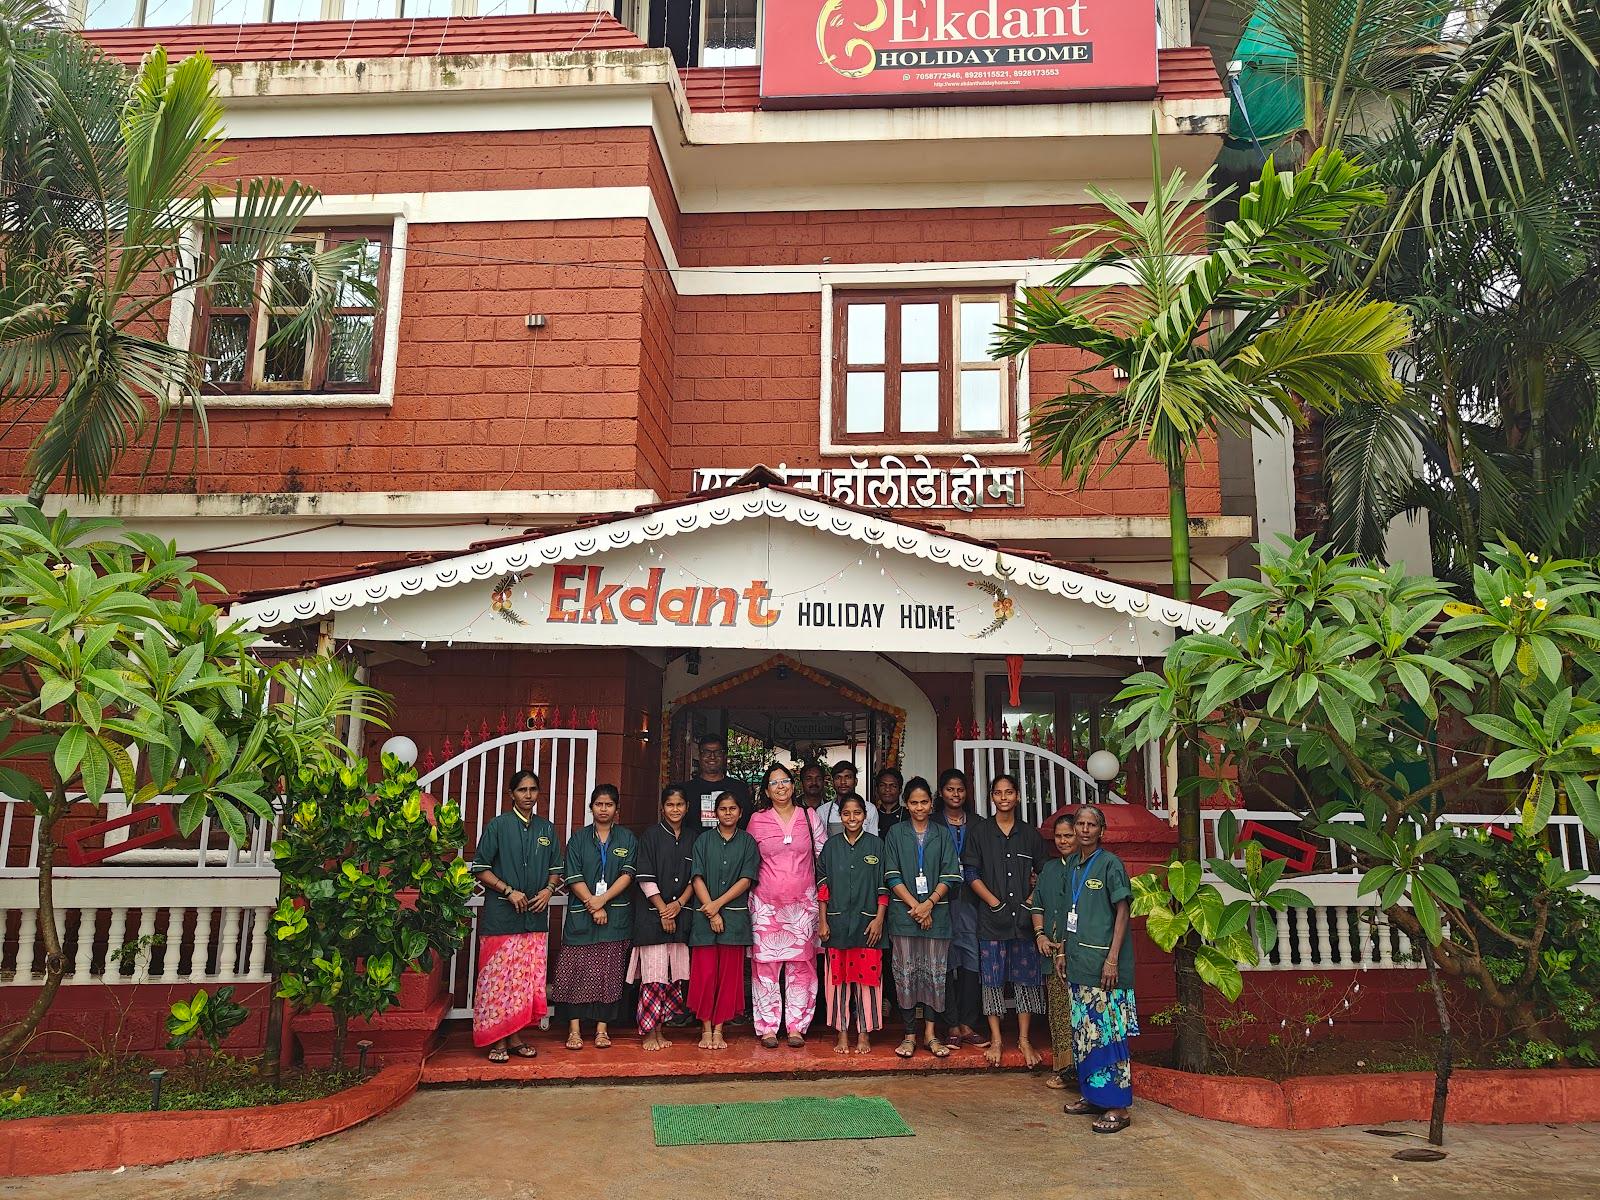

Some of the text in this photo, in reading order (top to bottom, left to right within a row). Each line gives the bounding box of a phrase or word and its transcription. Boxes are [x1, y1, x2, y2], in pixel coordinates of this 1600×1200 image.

[889, 0, 1089, 42] Ekdant
[880, 45, 1089, 67] HOLIDAY HOME
[546, 564, 955, 630] Ekdant HOLIDAY HOME
